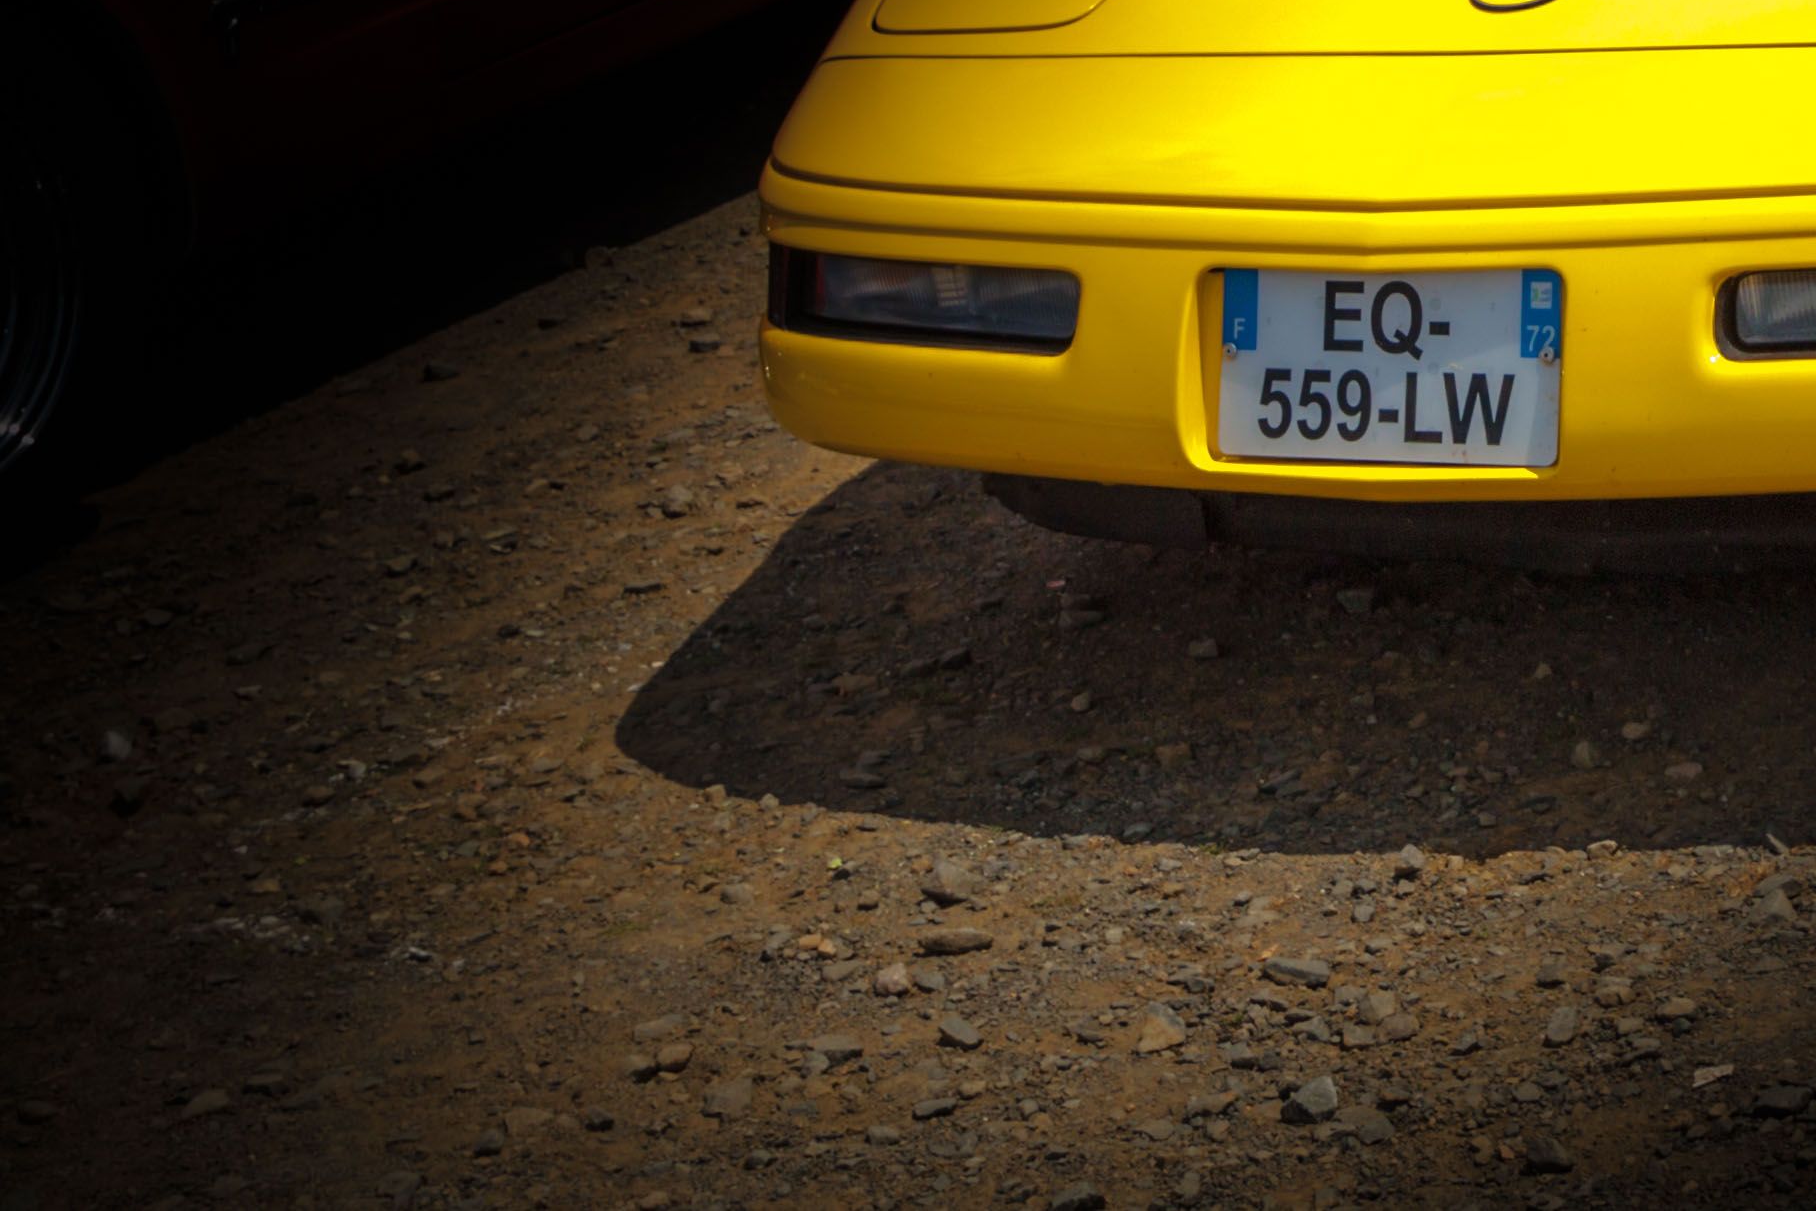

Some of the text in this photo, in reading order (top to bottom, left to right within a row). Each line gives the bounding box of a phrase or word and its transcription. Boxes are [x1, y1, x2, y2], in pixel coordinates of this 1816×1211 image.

[1232, 318, 1246, 340] F
[1526, 324, 1556, 352] 72
[1257, 368, 1516, 446] 559-LW
